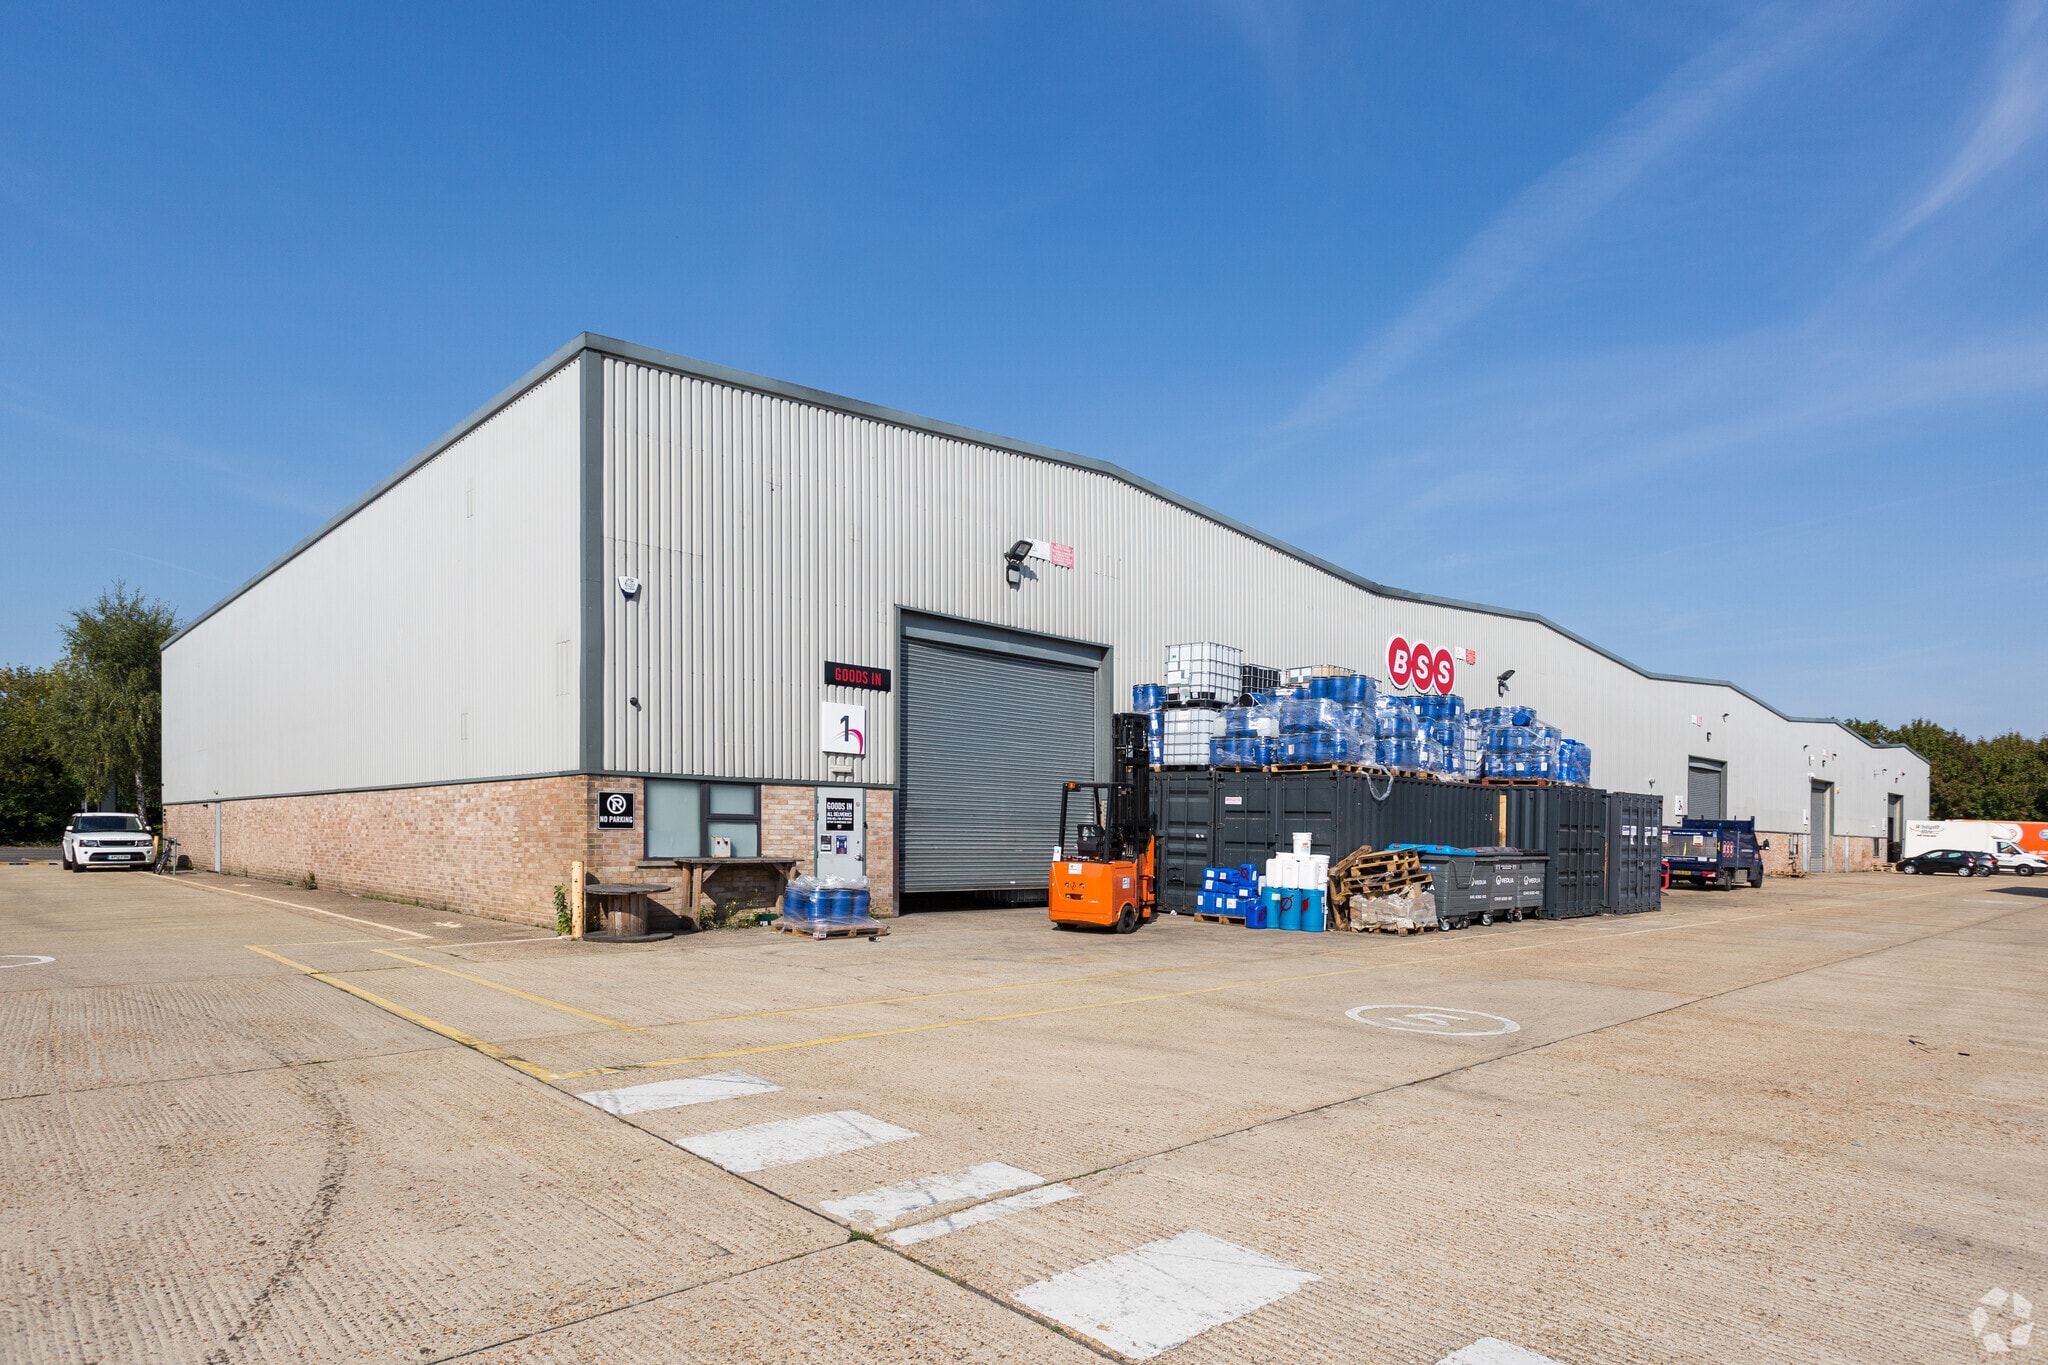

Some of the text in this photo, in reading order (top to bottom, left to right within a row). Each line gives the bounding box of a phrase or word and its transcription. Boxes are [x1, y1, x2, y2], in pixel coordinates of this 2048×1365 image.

[1393, 649, 1451, 684] BSS
[835, 667, 882, 686] GOODS IN
[840, 715, 849, 742] 1
[826, 801, 853, 811] GOODS IN
[600, 815, 633, 824] NO PARKING
